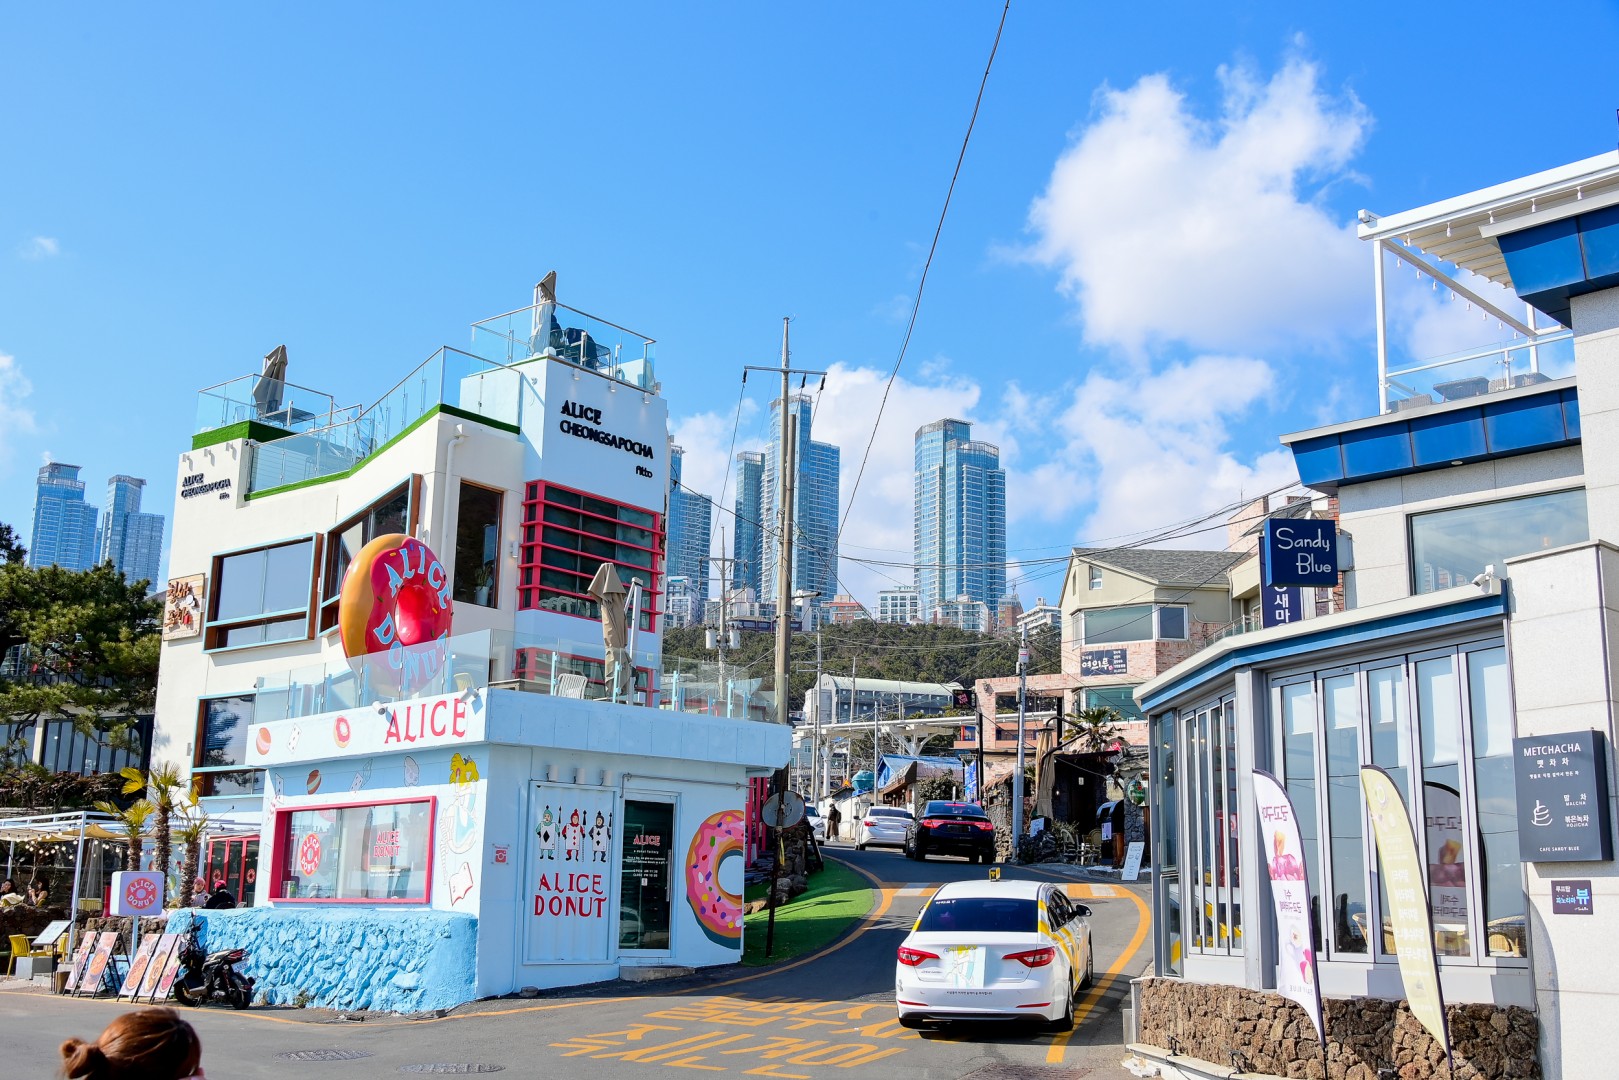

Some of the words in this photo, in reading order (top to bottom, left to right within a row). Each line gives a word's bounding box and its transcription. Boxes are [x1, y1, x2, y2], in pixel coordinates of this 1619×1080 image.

[561, 400, 602, 425] ALICE
[560, 420, 654, 459] CHEONGSAPOCHA
[182, 472, 204, 487] ALICE
[1275, 527, 1330, 552] Sandy
[1295, 552, 1332, 575] Blue
[384, 546, 450, 610] ALICE
[373, 612, 448, 683] DONUT
[384, 698, 467, 744] ALICE
[1523, 742, 1581, 757] METCHACHA
[376, 830, 400, 845] ALICE
[633, 833, 661, 847] ALICE
[373, 845, 401, 858] DONUT
[130, 880, 155, 893] ALICE
[538, 873, 604, 895] ALICE
[127, 894, 155, 907] DONUT
[534, 895, 607, 918] DONUT
[1576, 888, 1590, 905] 뷰
[548, 1023, 909, 1080] 즉시견인
